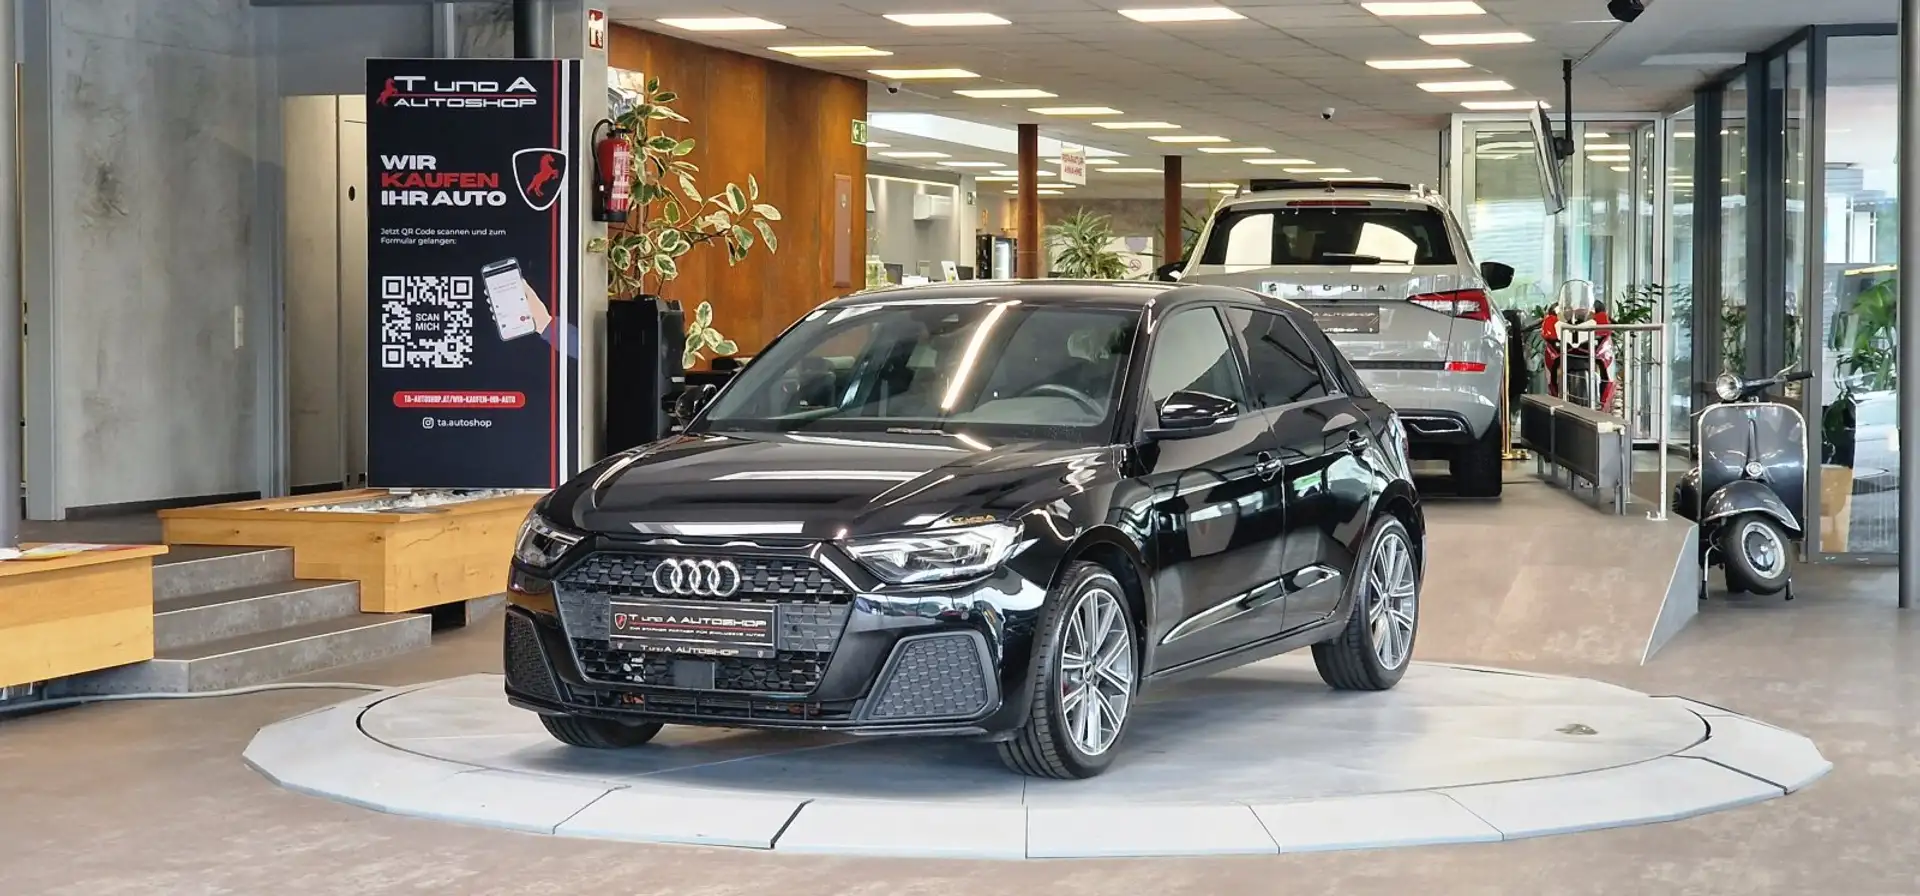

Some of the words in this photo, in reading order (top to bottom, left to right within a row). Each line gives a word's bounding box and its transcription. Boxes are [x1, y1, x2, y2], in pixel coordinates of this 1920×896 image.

[393, 75, 427, 92] T
[505, 76, 538, 93] A
[393, 98, 538, 108] AUTOSHOP
[380, 154, 437, 170] WIR
[381, 172, 499, 188] KAUFEN
[381, 190, 429, 206] IHR
[431, 190, 507, 206] AUTO
[400, 228, 414, 236] QR
[417, 237, 457, 246] gelangen:
[415, 313, 440, 321] SCAN
[415, 322, 440, 331] MICH
[437, 418, 493, 428] ta.autoshop
[627, 613, 639, 622] T
[680, 617, 767, 628] AUTOSHOP
[640, 644, 649, 652] T
[675, 646, 740, 656] AUTOSHOP
